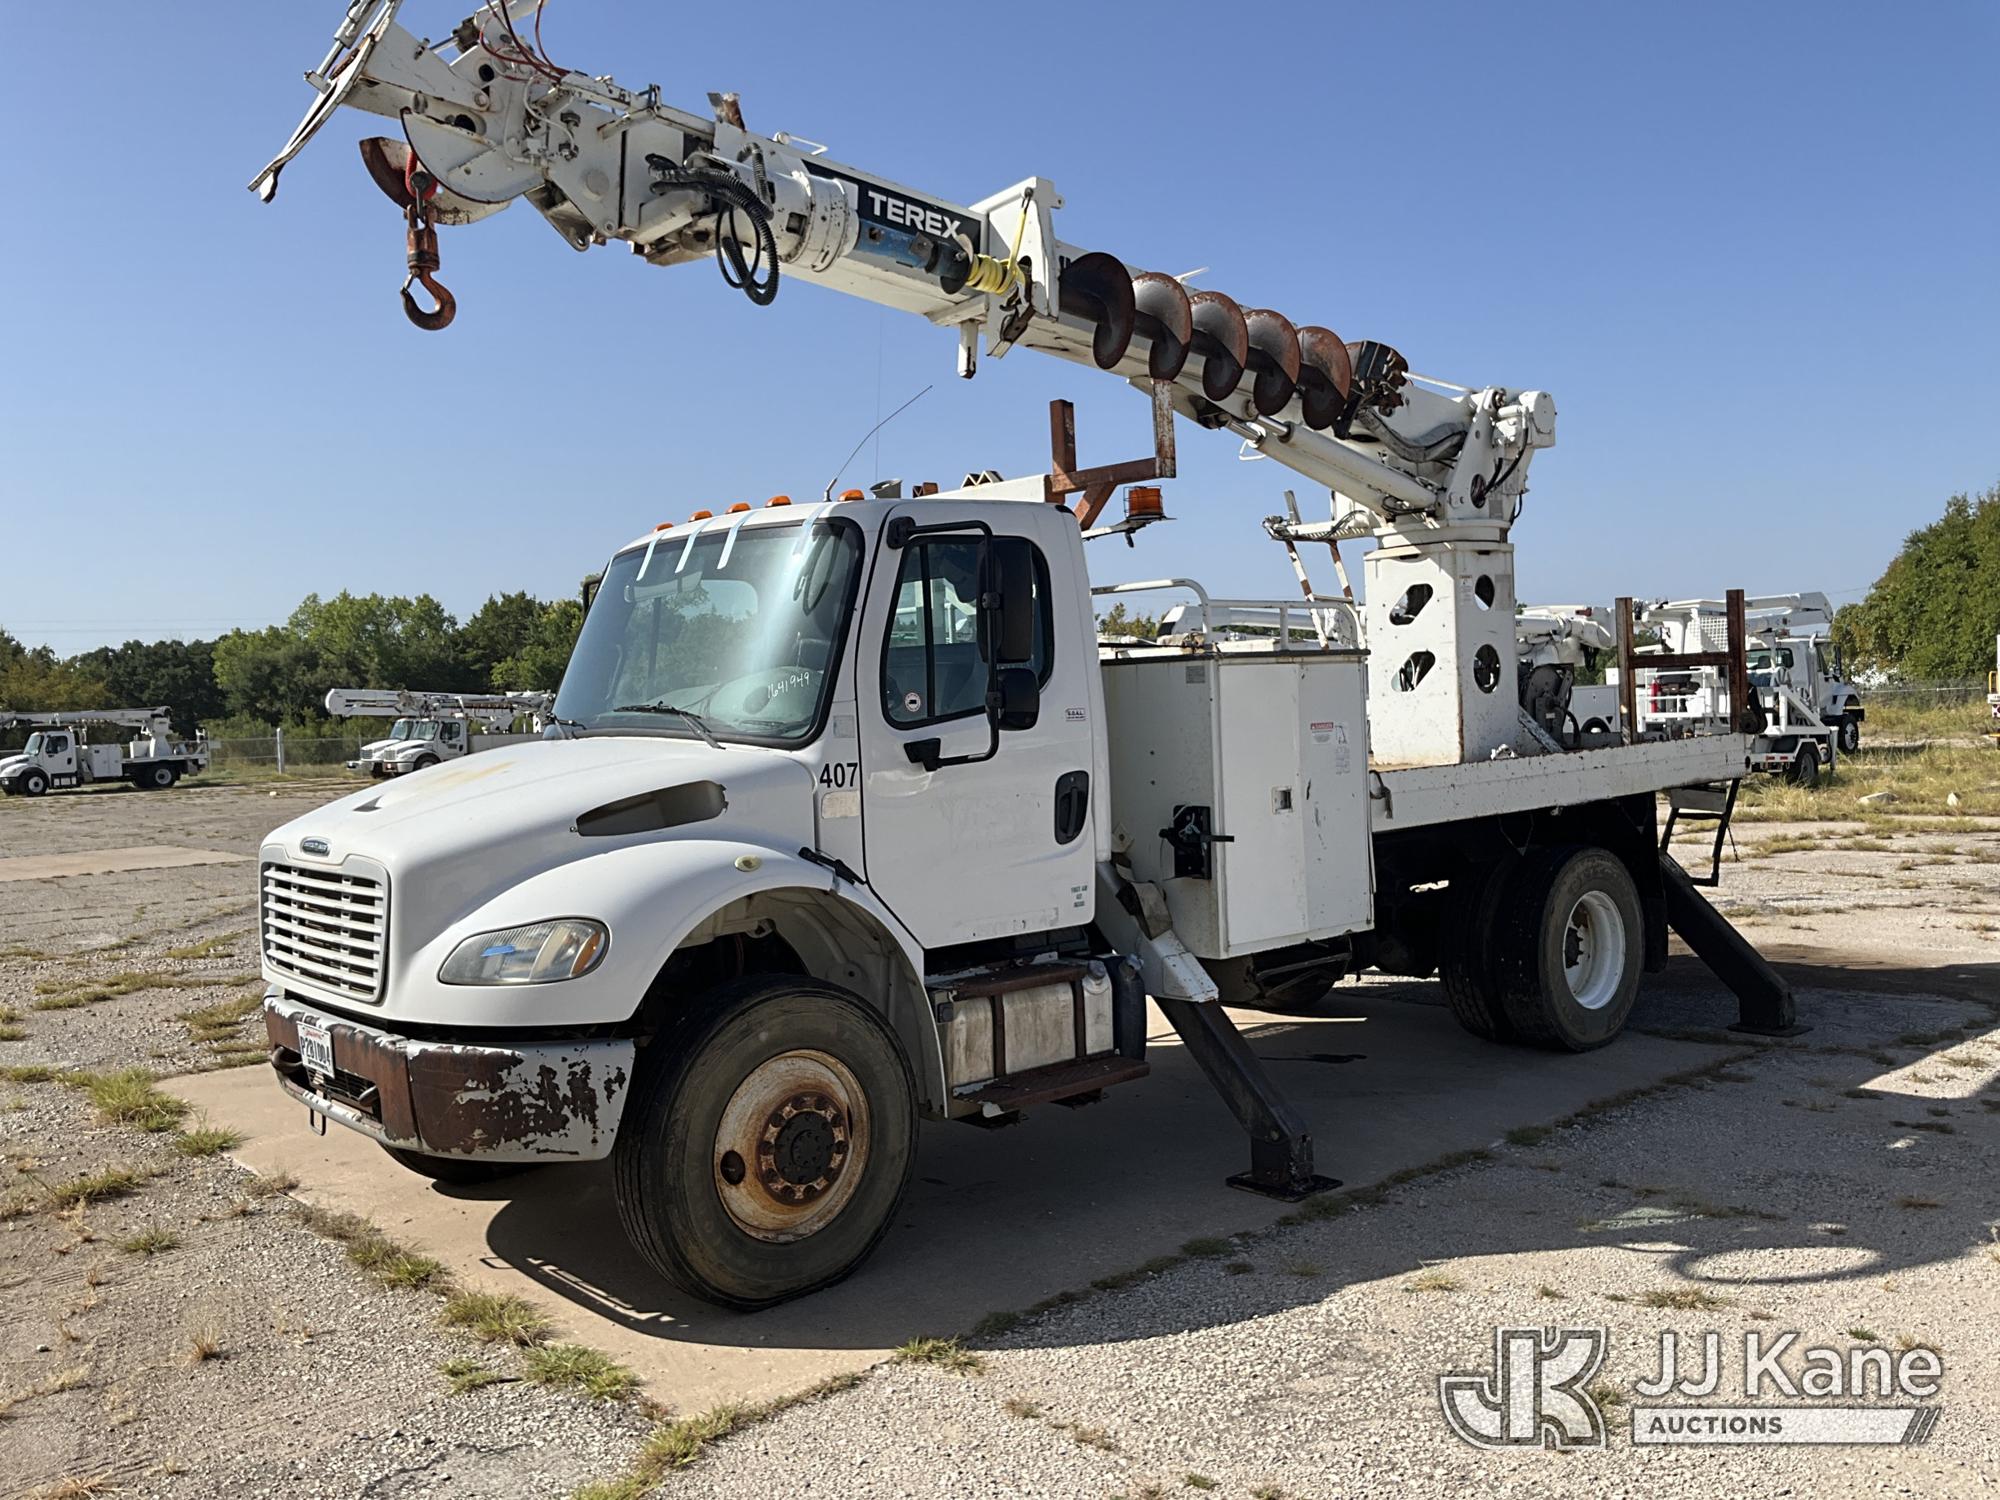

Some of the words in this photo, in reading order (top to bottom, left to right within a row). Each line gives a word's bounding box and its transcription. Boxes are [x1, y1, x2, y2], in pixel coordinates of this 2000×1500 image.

[868, 190, 961, 239] TEREX
[767, 671, 810, 699] 1641949
[820, 762, 858, 788] 407
